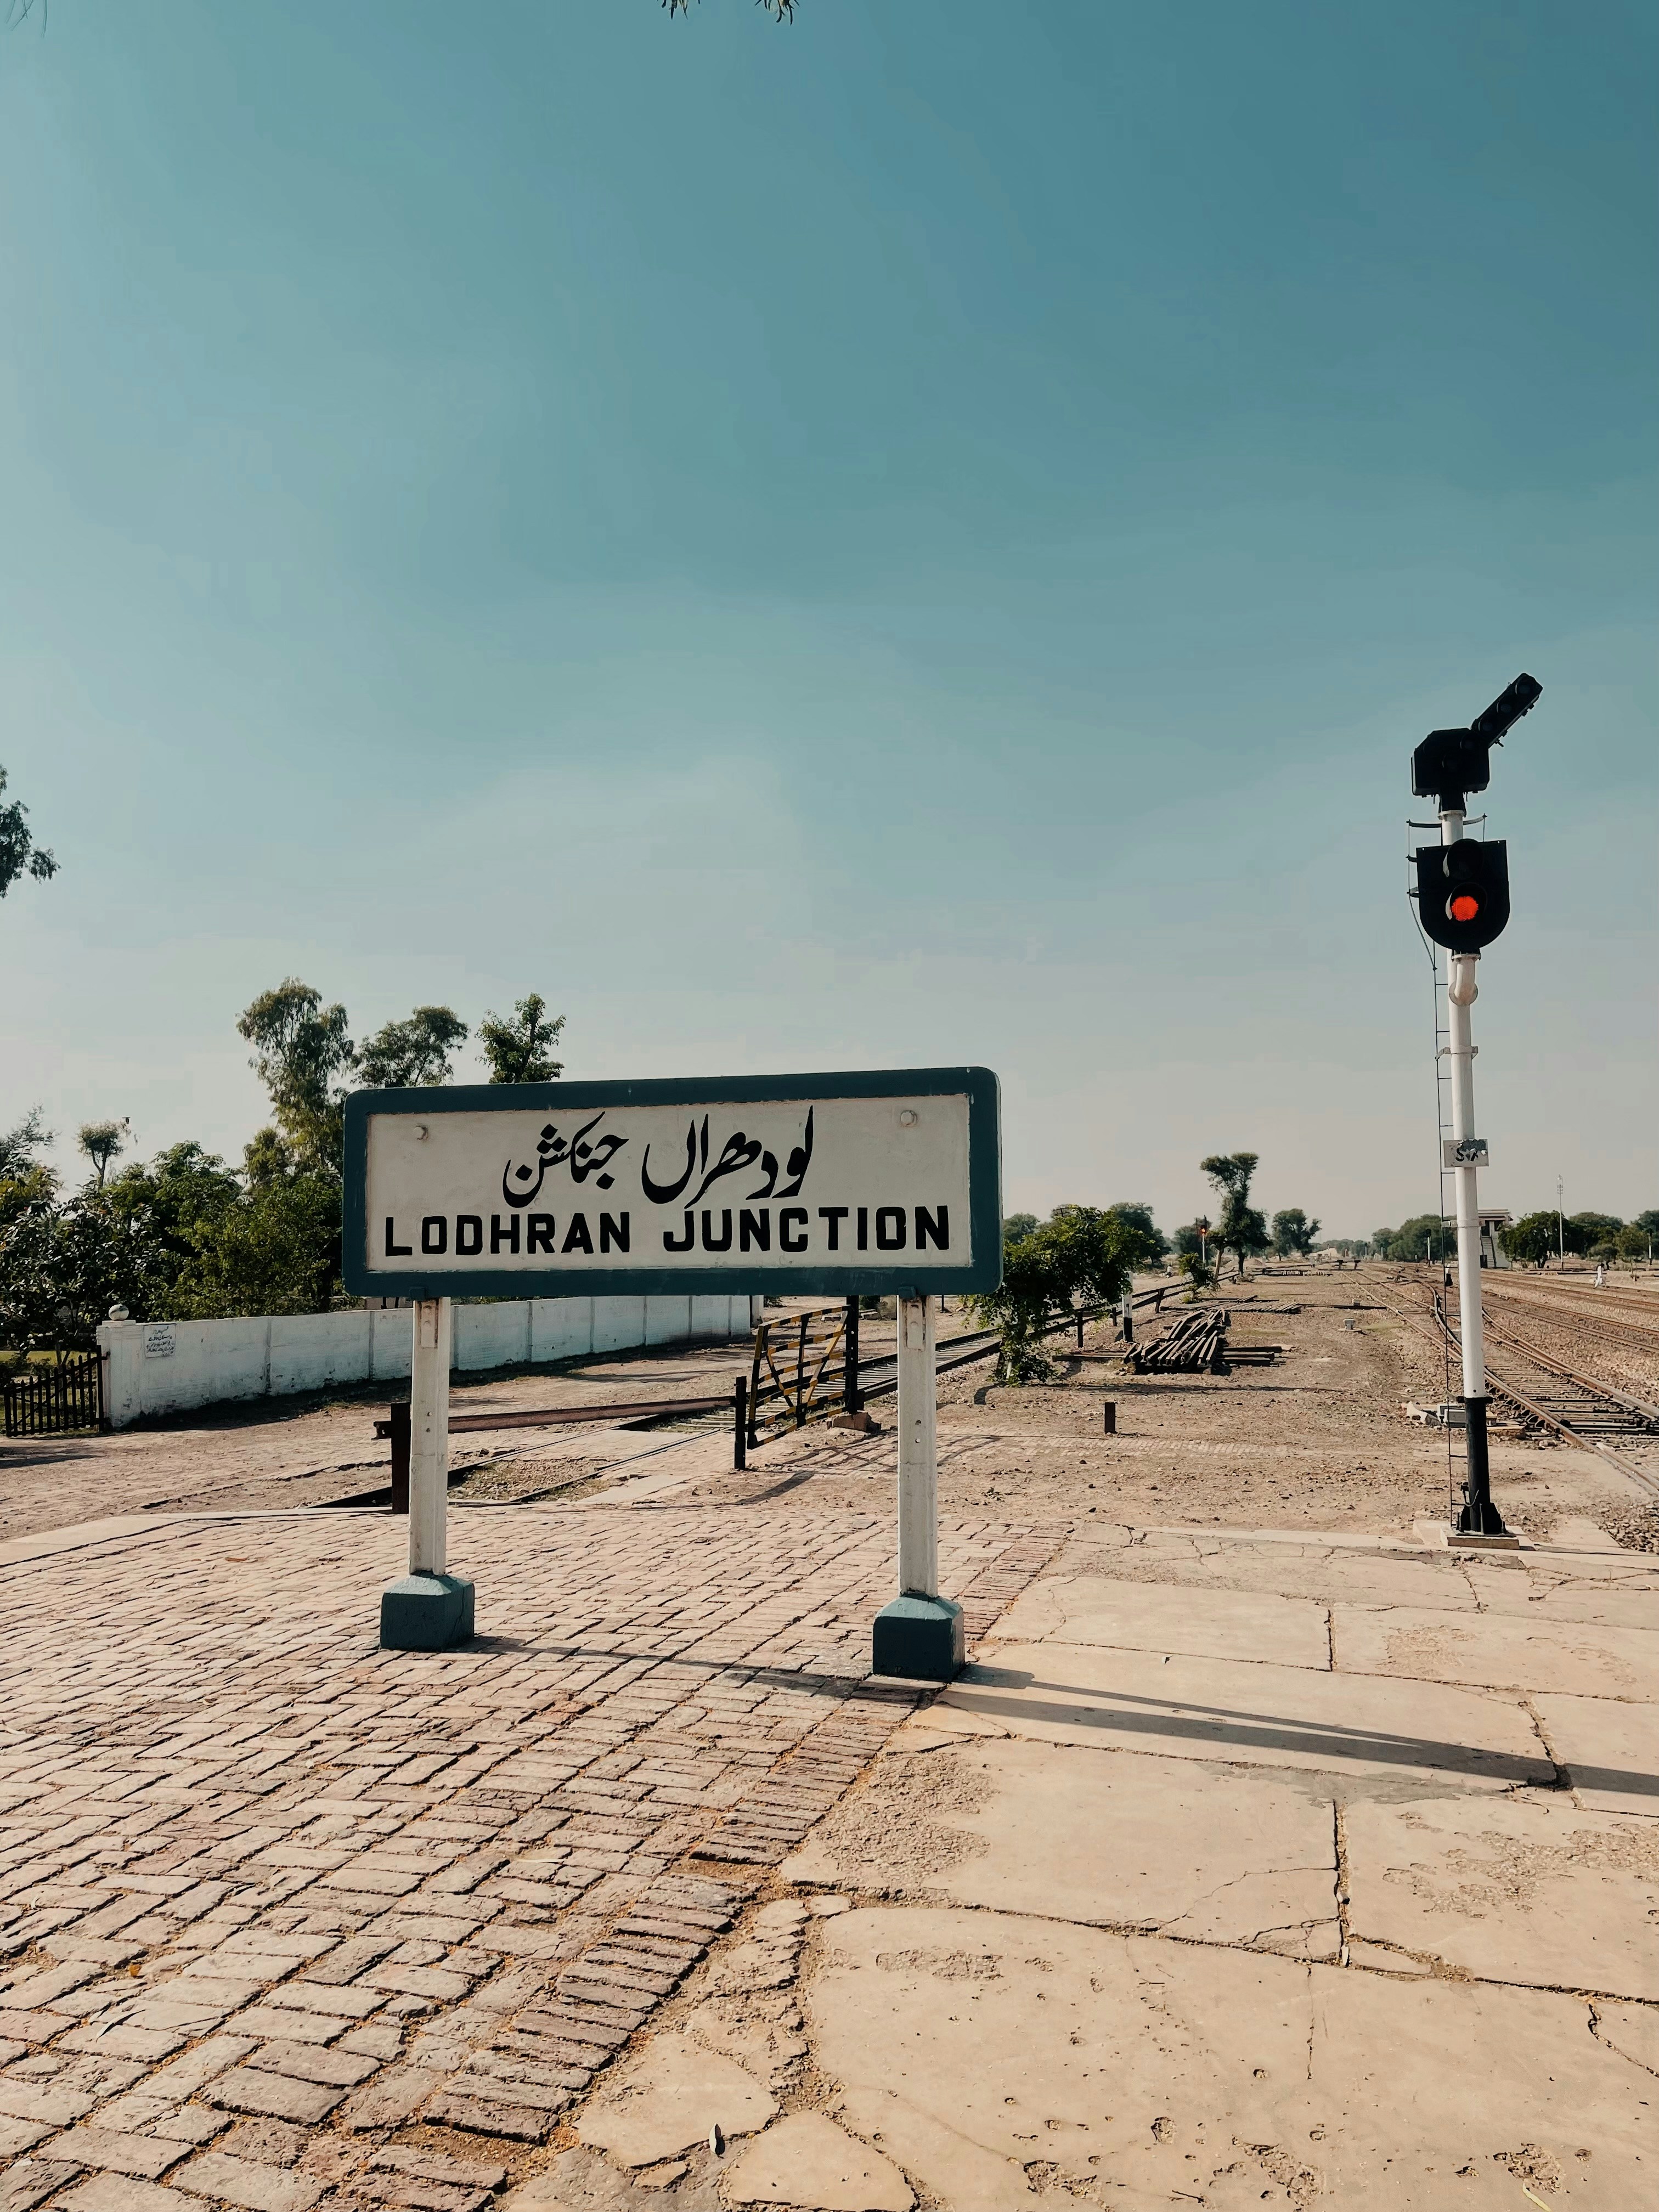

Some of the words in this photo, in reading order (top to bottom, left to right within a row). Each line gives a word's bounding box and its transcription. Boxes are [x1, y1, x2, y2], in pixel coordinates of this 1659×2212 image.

[502, 1110, 630, 1209] جنکشن
[385, 1211, 631, 1257] LODHRAN
[662, 1205, 950, 1253] JUNCTION
